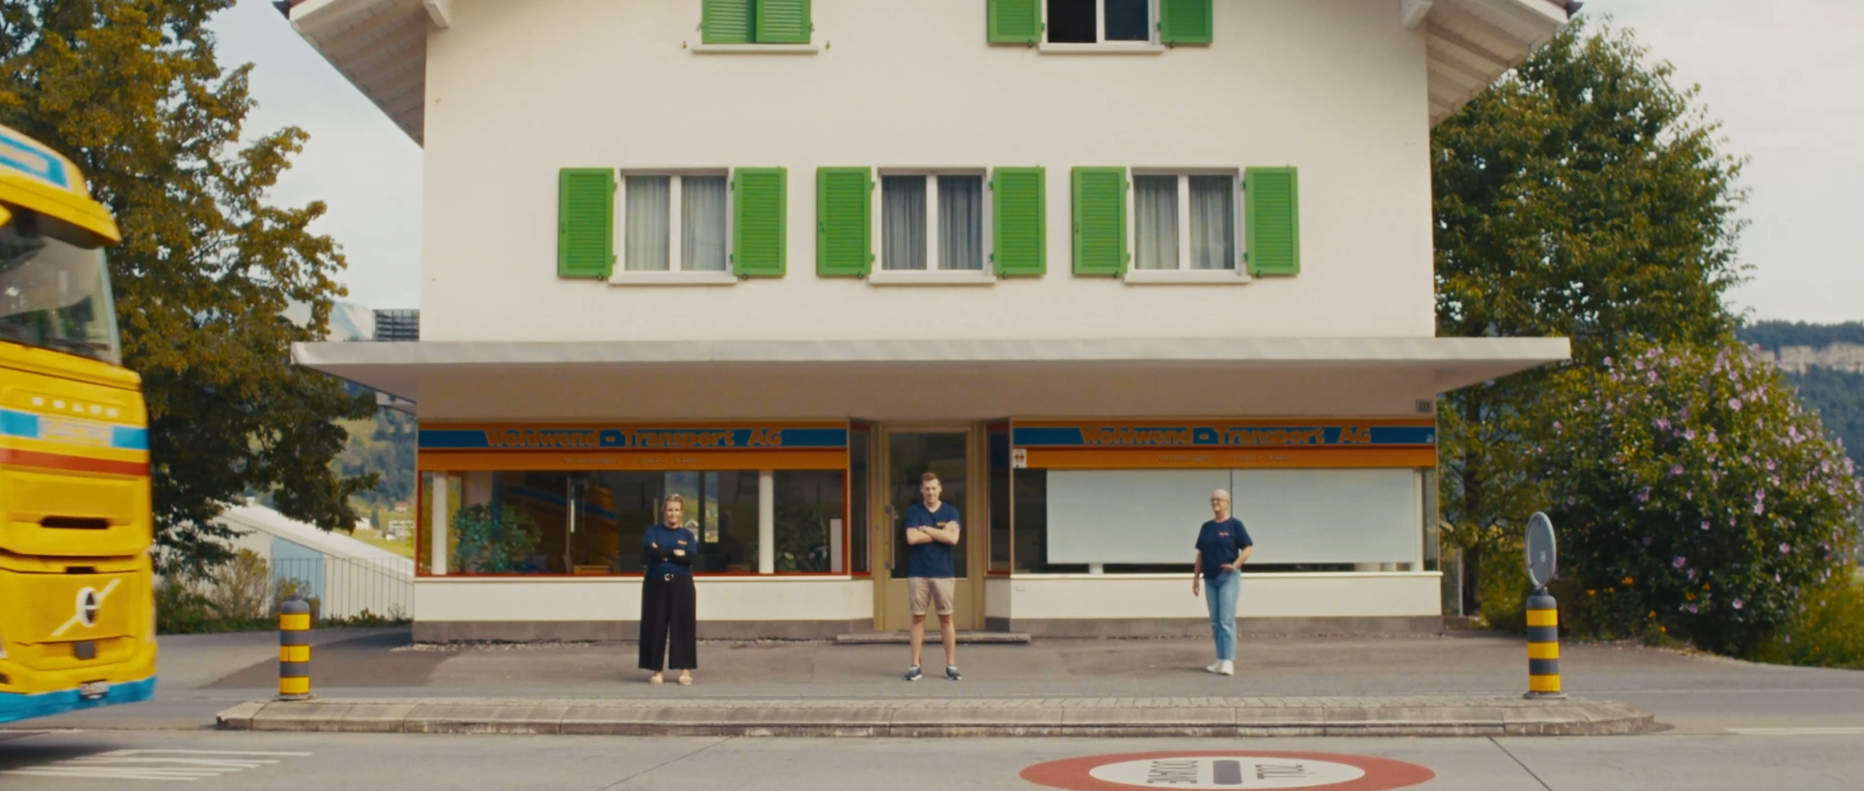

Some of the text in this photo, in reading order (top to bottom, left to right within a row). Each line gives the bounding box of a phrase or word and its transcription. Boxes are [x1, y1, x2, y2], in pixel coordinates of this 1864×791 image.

[485, 429, 599, 447] Wohlwend
[621, 429, 733, 448] Transport
[747, 429, 781, 447] AG
[1080, 427, 1192, 444] Wohlwend
[1213, 427, 1325, 446] Transport
[1337, 427, 1371, 444] AG
